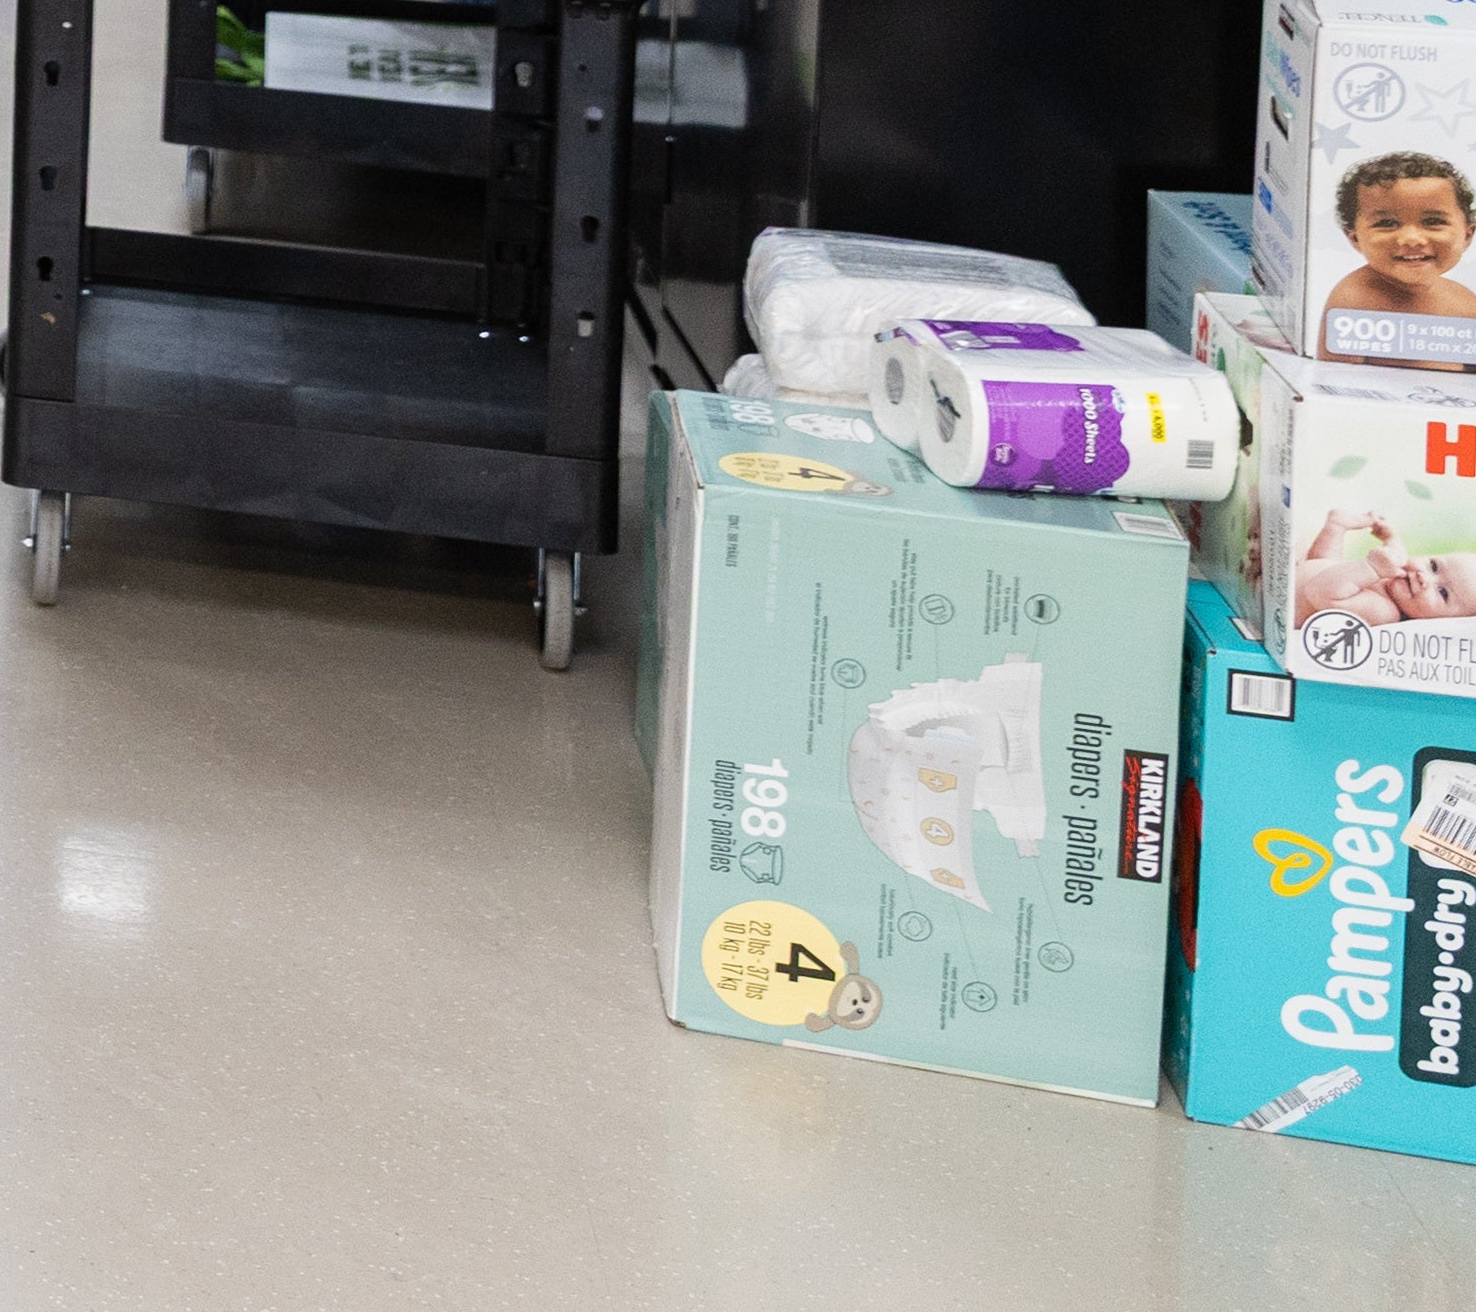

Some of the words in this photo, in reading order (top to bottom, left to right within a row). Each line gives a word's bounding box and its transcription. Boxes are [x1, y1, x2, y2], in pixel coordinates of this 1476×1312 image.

[1330, 41, 1353, 58] DO
[1355, 43, 1387, 60] NOT
[1390, 44, 1438, 62] FLUSH
[1334, 316, 1395, 341] 900
[1407, 323, 1417, 335] 9
[1430, 324, 1453, 337] 100
[1336, 338, 1392, 353] WIPES
[1408, 337, 1422, 352] 18
[1425, 340, 1450, 353] cm
[1078, 387, 1099, 420] 1000
[1083, 421, 1100, 464] Sheets
[1379, 629, 1409, 655] DO
[1413, 633, 1454, 660] NOT
[1376, 658, 1405, 679] PAS
[1409, 661, 1440, 683] AUX
[1067, 711, 1113, 799] diapers
[709, 758, 737, 812] diapers
[740, 756, 790, 839] 198
[1120, 755, 1142, 876] Signature
[1135, 757, 1166, 879] KIRKLAND
[707, 817, 737, 874] pañales
[1061, 813, 1105, 907] pañales
[1280, 758, 1416, 1053] Pampers
[749, 919, 773, 935] 22
[718, 937, 743, 953] kg
[748, 937, 772, 957] lbs
[746, 965, 770, 980] 37
[774, 941, 837, 985] 4
[745, 982, 770, 1000] lbs
